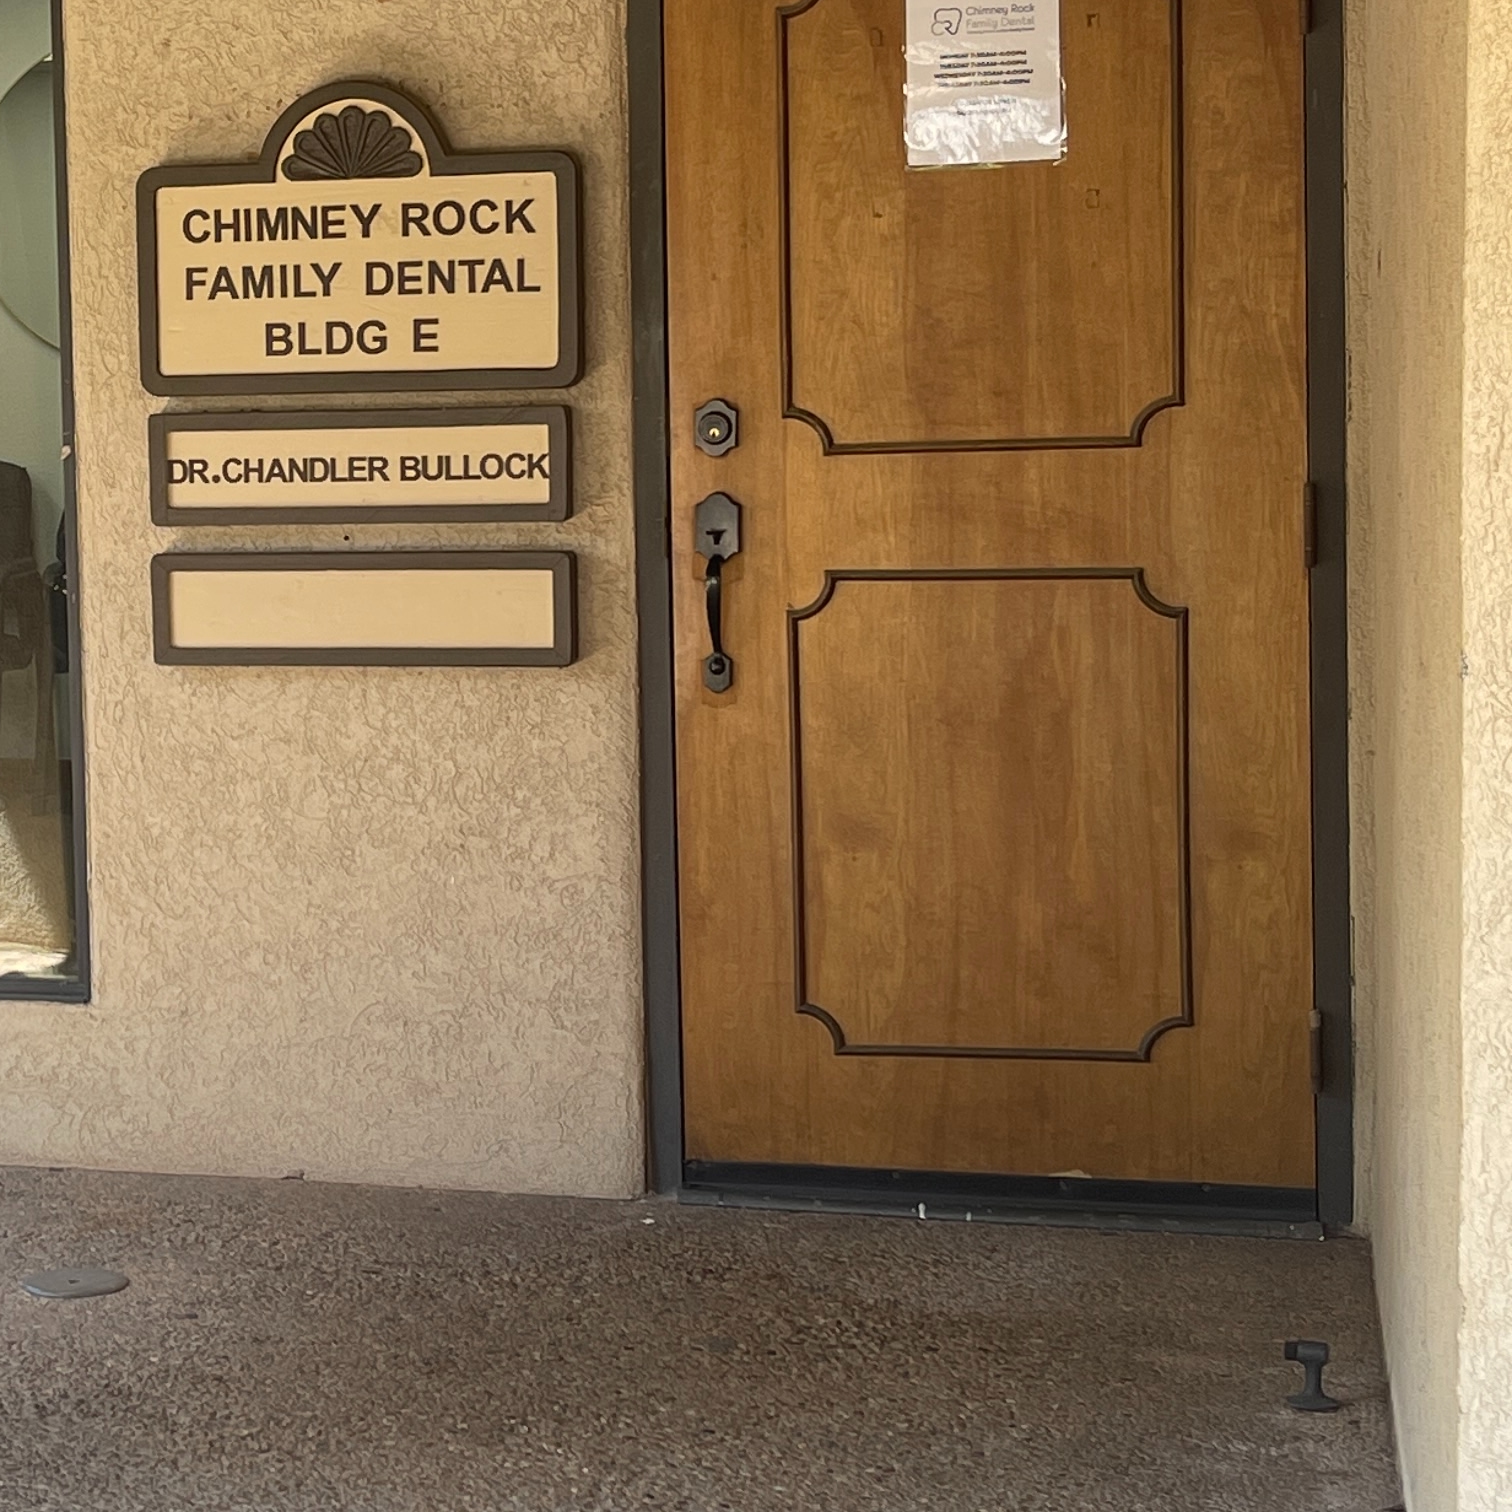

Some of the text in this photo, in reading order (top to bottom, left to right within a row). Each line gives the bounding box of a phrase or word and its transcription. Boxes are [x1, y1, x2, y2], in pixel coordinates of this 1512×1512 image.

[965, 2, 1035, 16] Chimney Rock
[966, 15, 1035, 29] Family Dental
[182, 198, 536, 244] CHIMNEY ROCK
[184, 258, 542, 301] FAMILY DENTAL
[264, 317, 440, 357] BLDG E
[399, 453, 550, 481] BULLOCK
